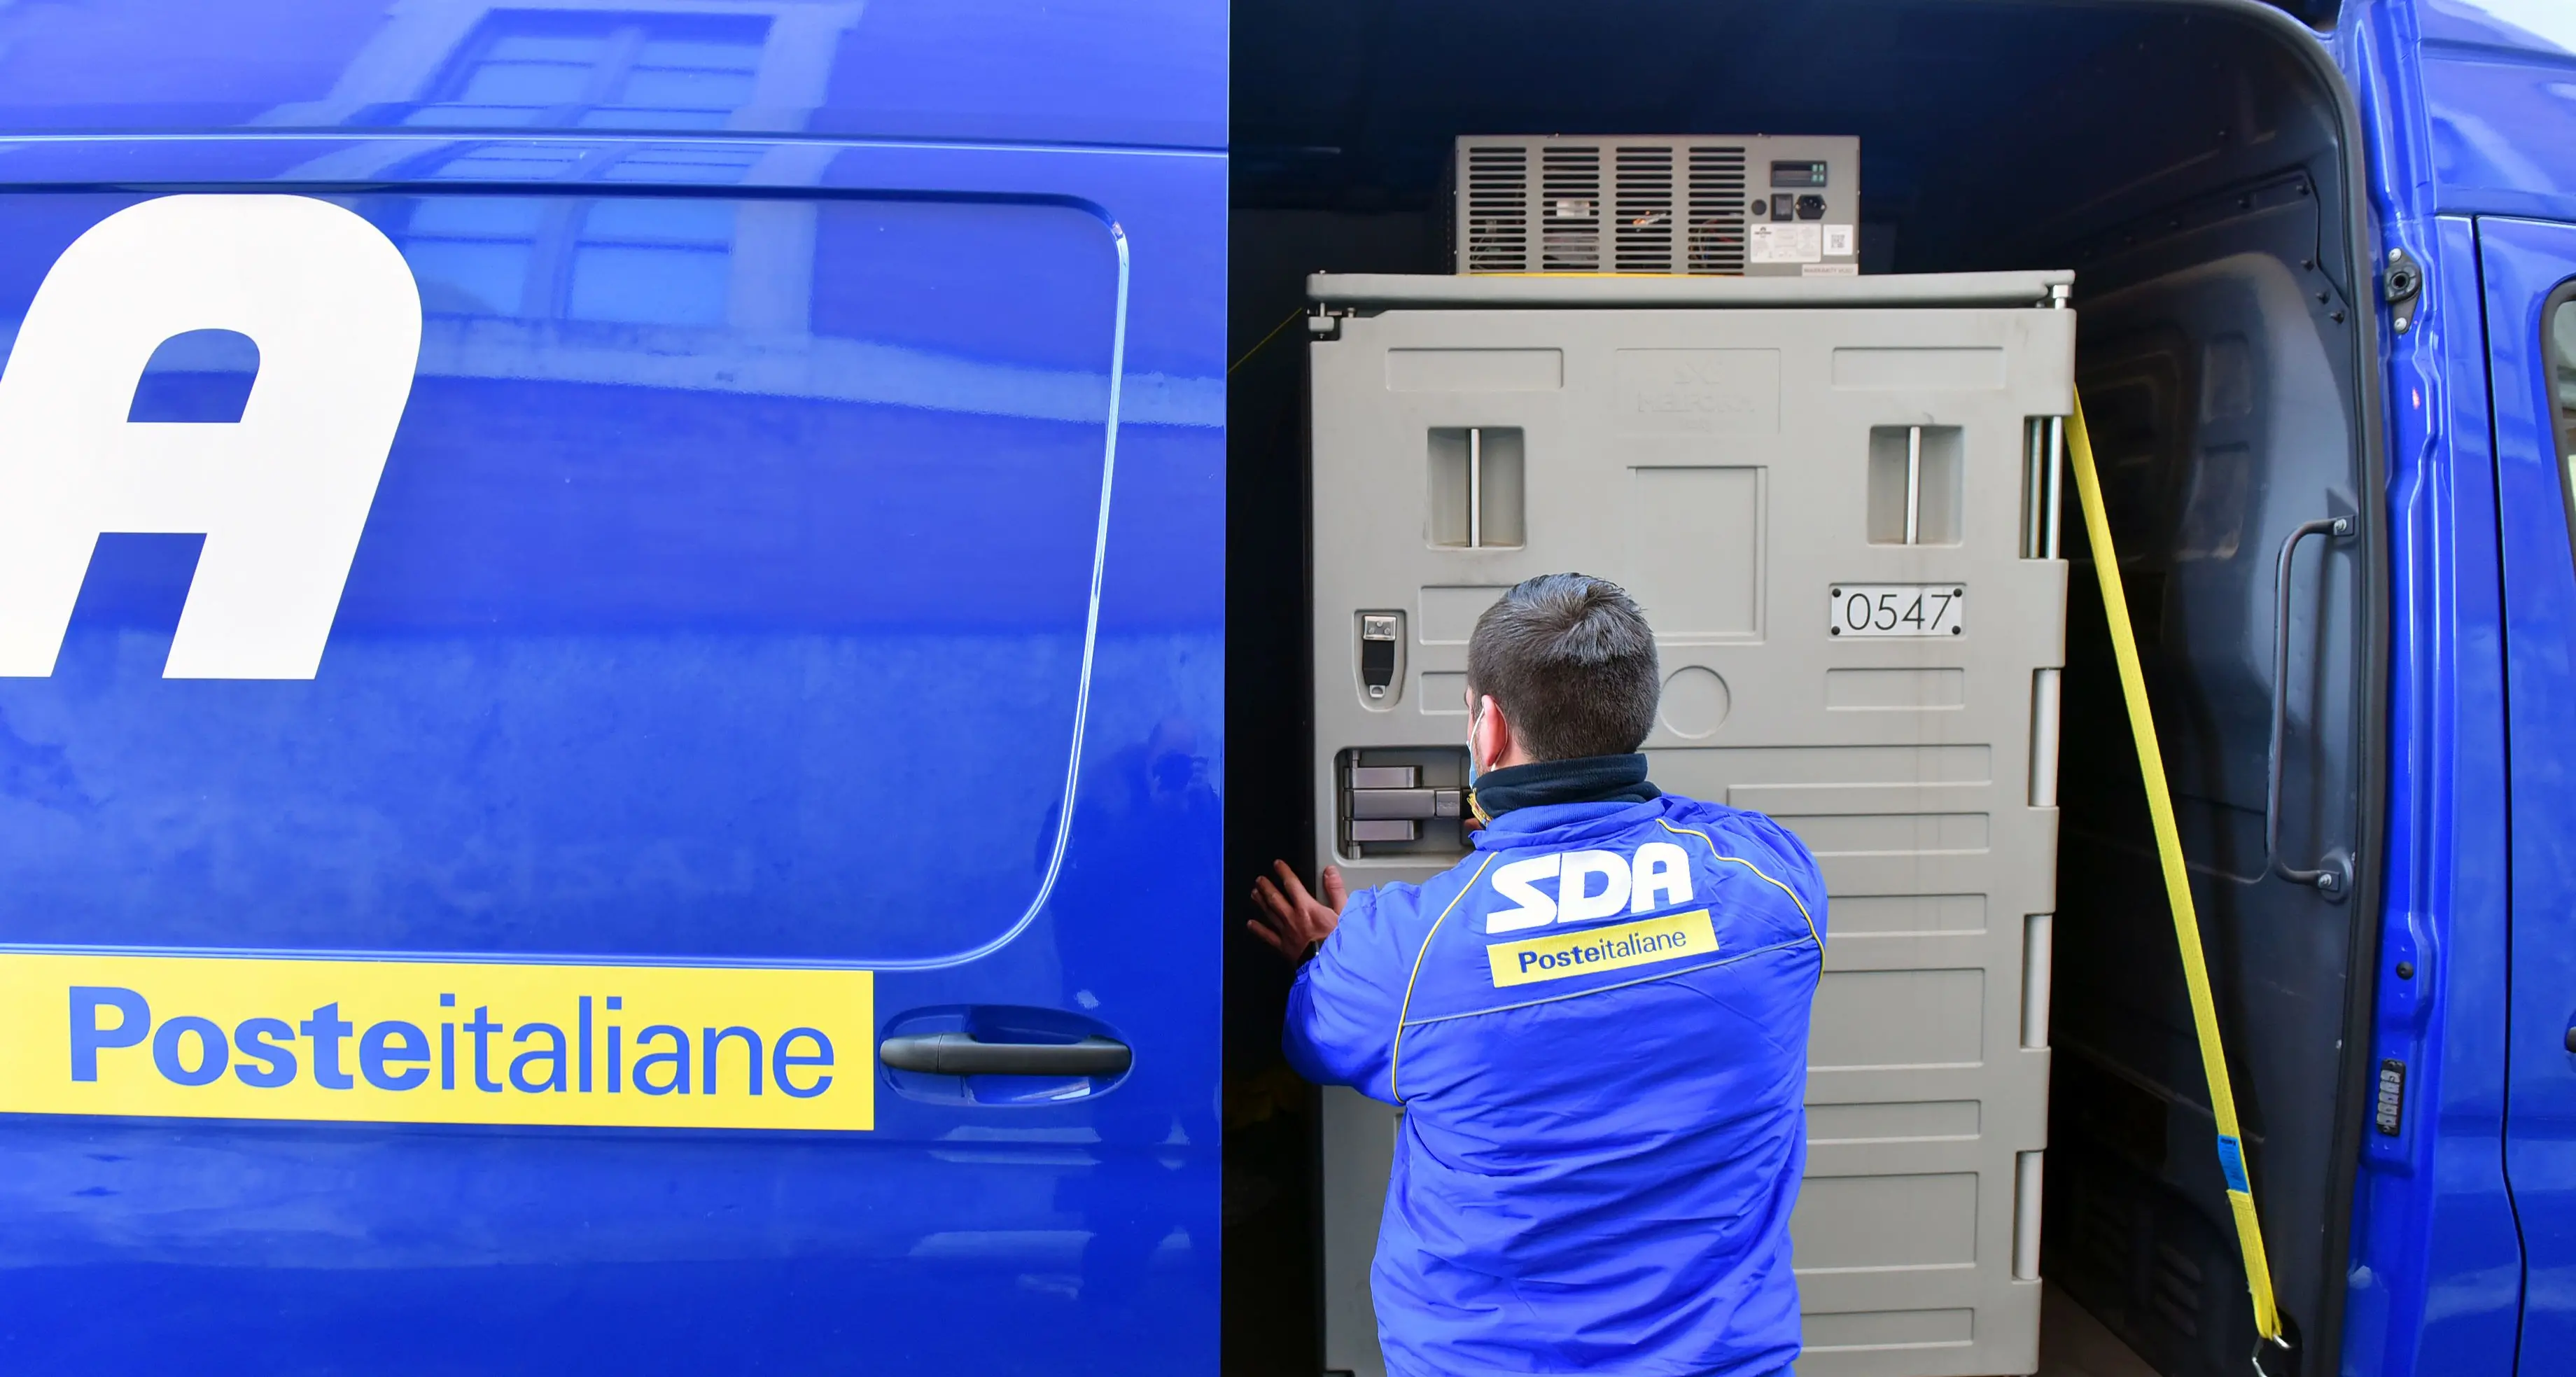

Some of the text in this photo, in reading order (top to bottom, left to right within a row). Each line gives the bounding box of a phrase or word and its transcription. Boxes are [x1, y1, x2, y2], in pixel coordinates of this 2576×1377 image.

[0, 194, 422, 680] A
[1846, 593, 1953, 631] 0547
[1485, 842, 1694, 935] SDA
[1518, 930, 1687, 973] Posteitaliane
[69, 986, 834, 1098] Posteitaliane
